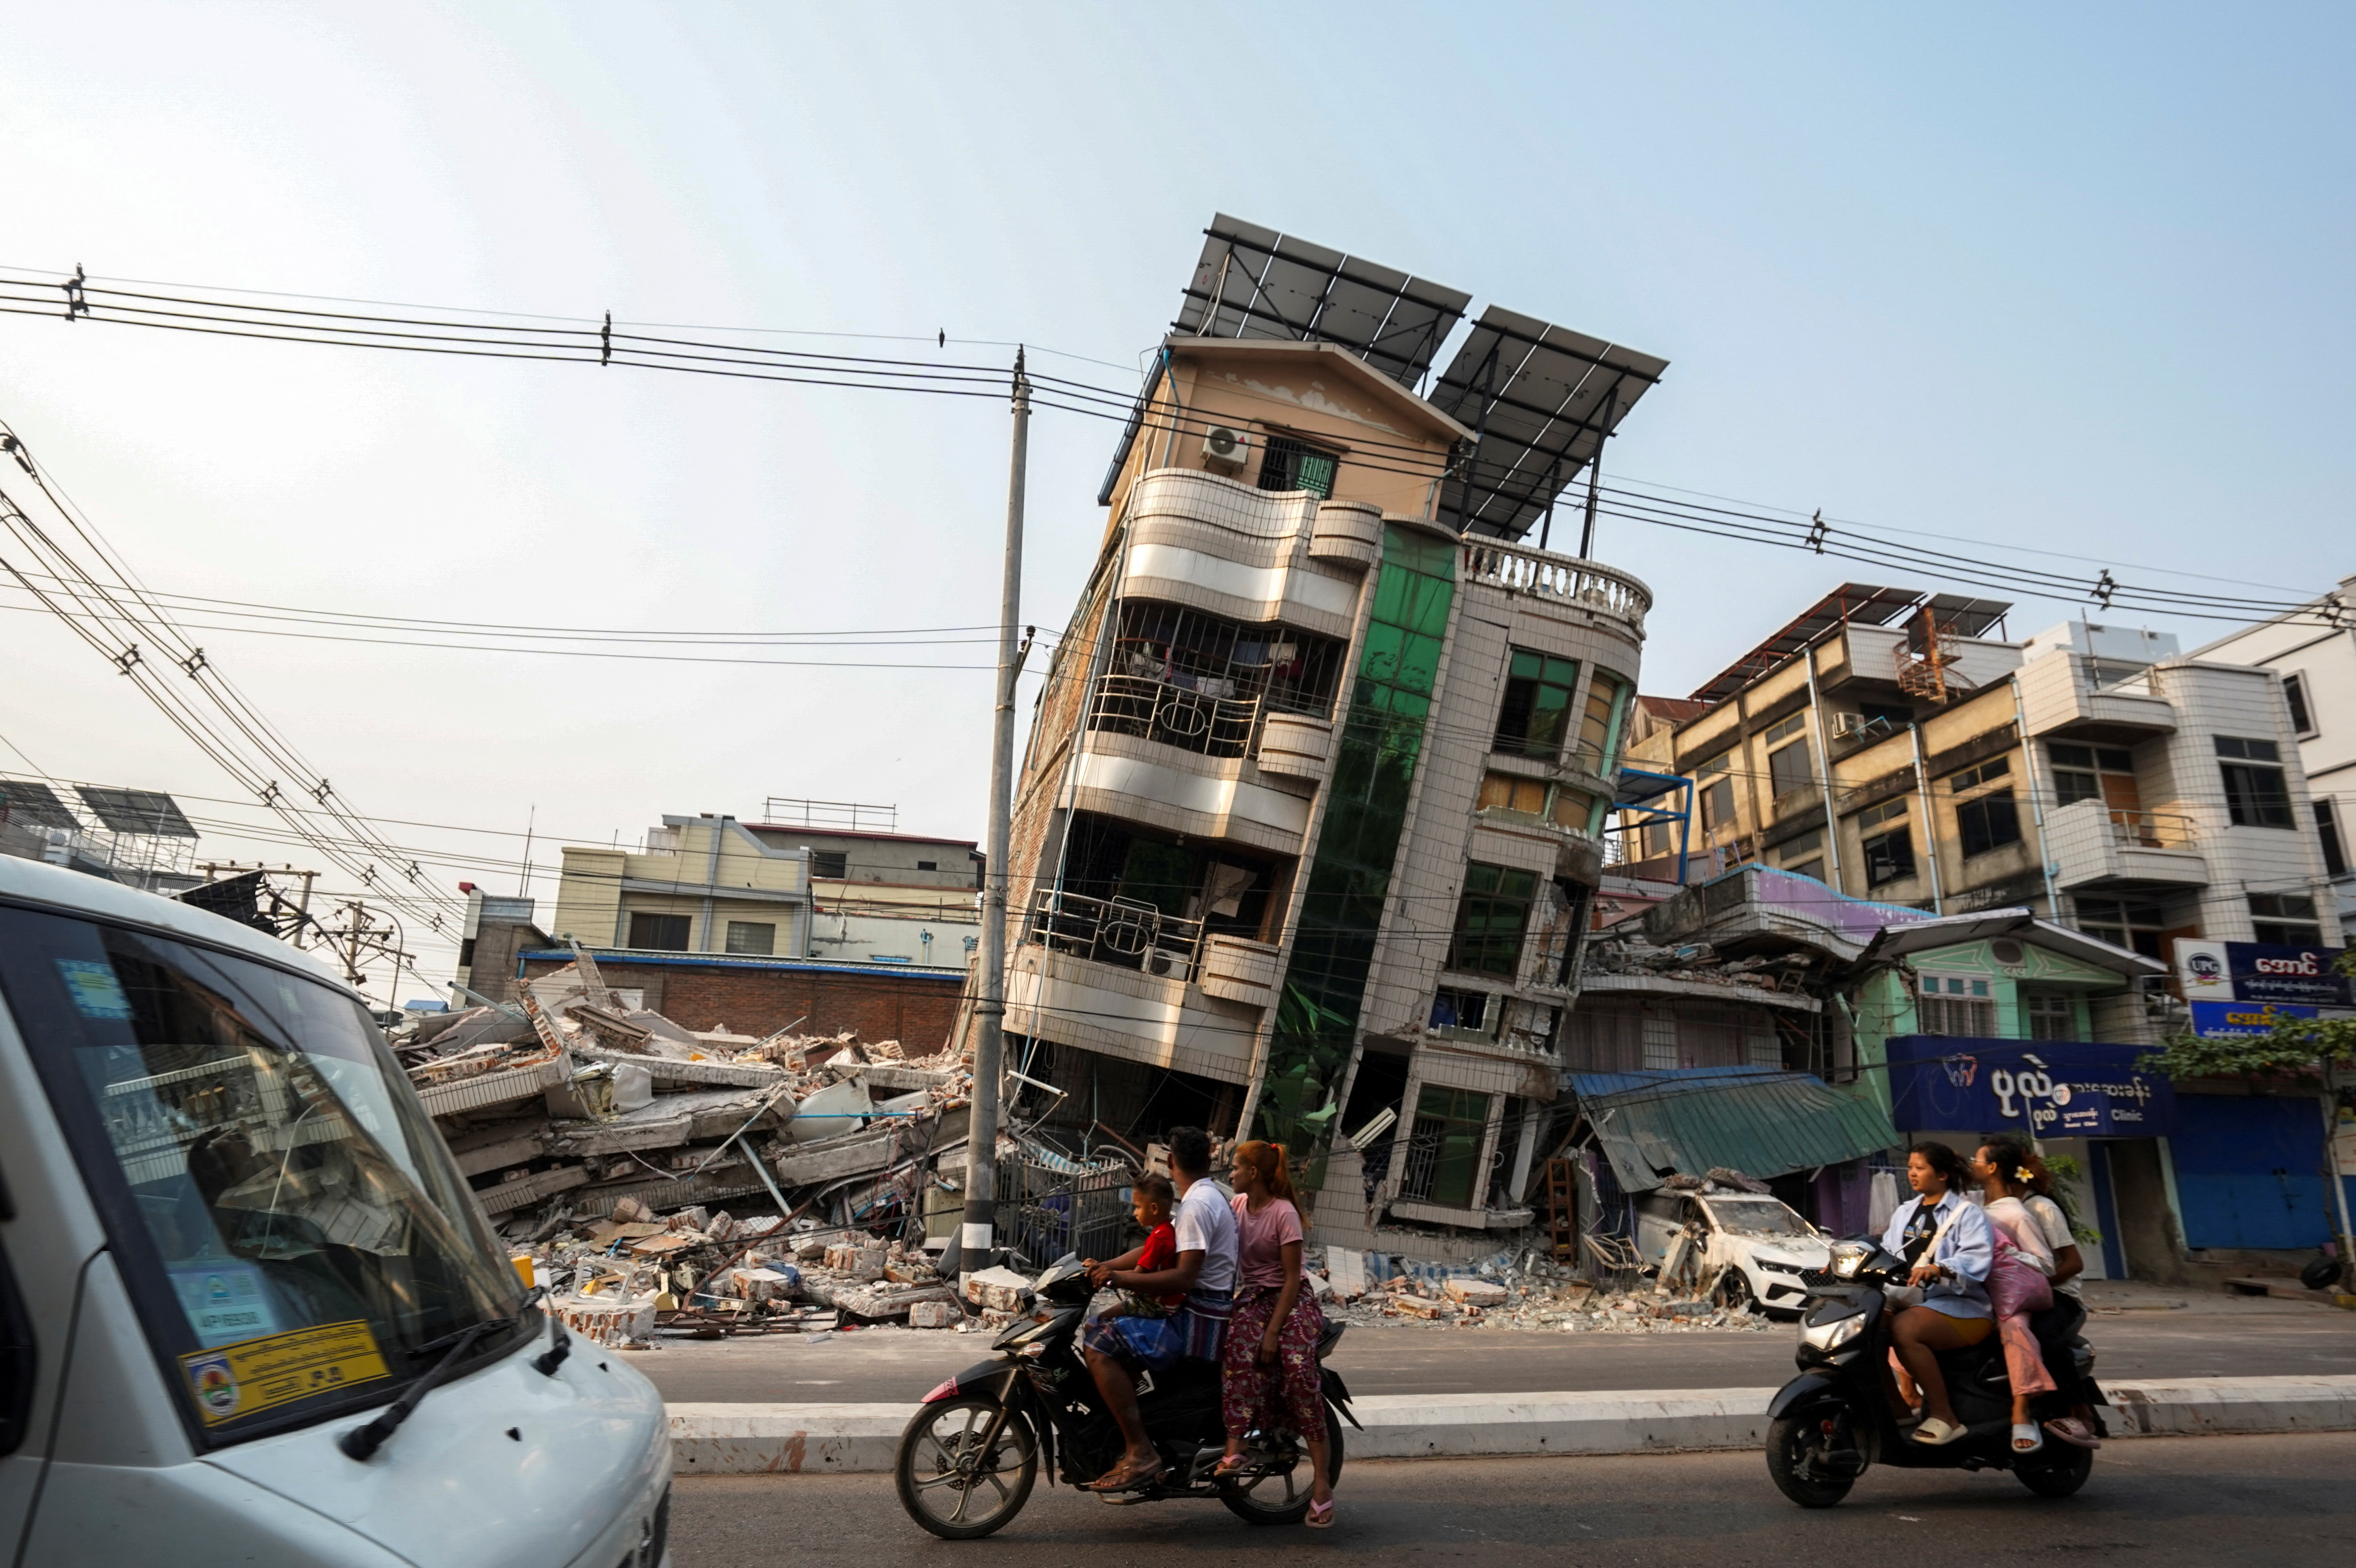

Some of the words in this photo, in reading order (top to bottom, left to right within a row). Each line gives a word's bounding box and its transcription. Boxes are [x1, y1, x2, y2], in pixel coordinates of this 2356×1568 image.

[2255, 952, 2319, 975] အောင်
[1991, 1054, 2053, 1117] ပုလဲ
[2033, 1102, 2058, 1130] ပုလဲ
[2111, 1109, 2143, 1121] Clinic
